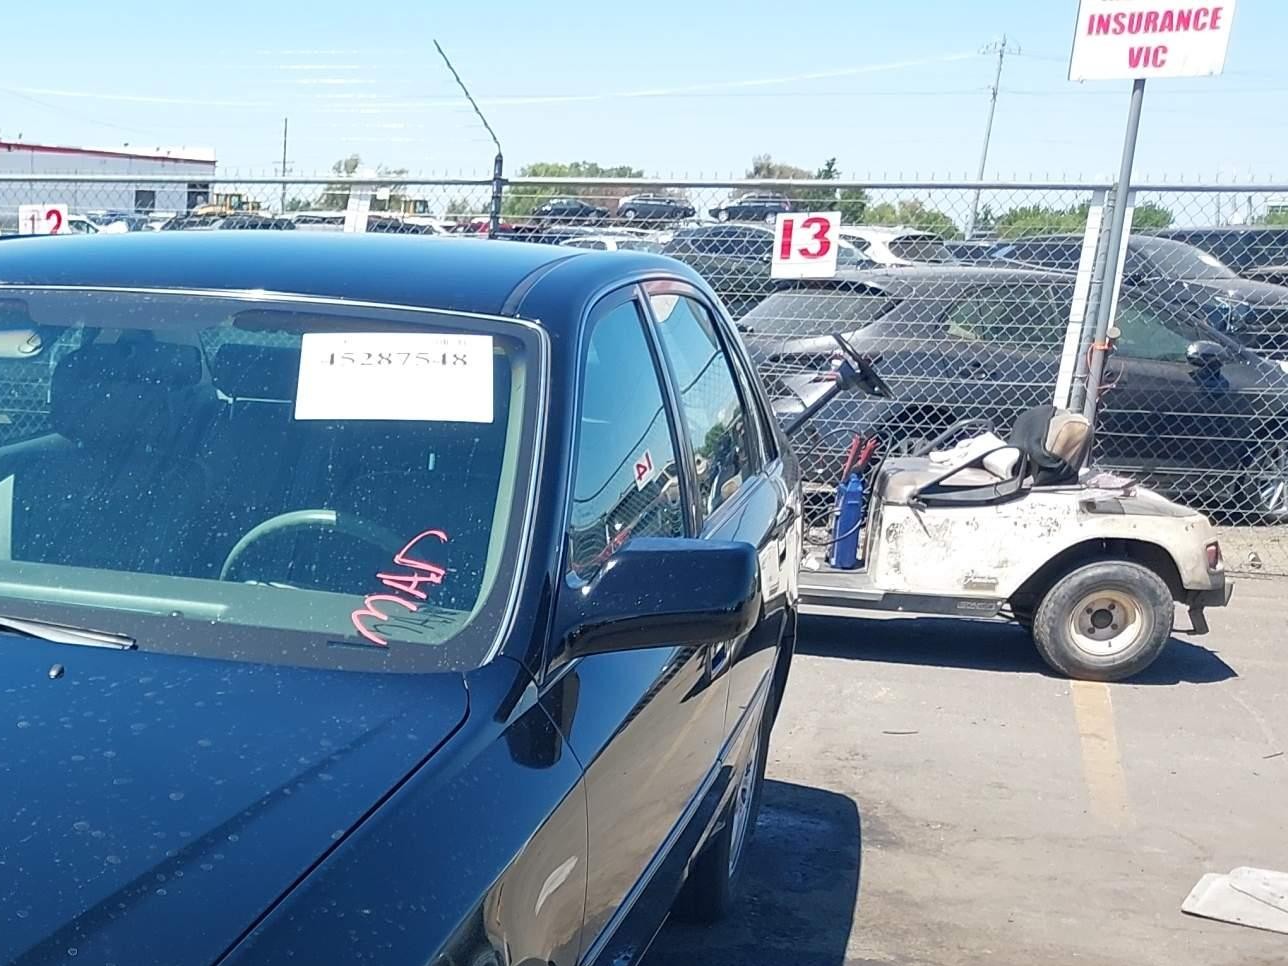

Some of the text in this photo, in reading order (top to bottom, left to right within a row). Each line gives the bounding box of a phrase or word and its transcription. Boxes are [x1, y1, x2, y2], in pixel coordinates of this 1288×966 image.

[1086, 6, 1224, 36] INSURANCE
[1128, 45, 1169, 69] VIC
[780, 217, 831, 259] 13
